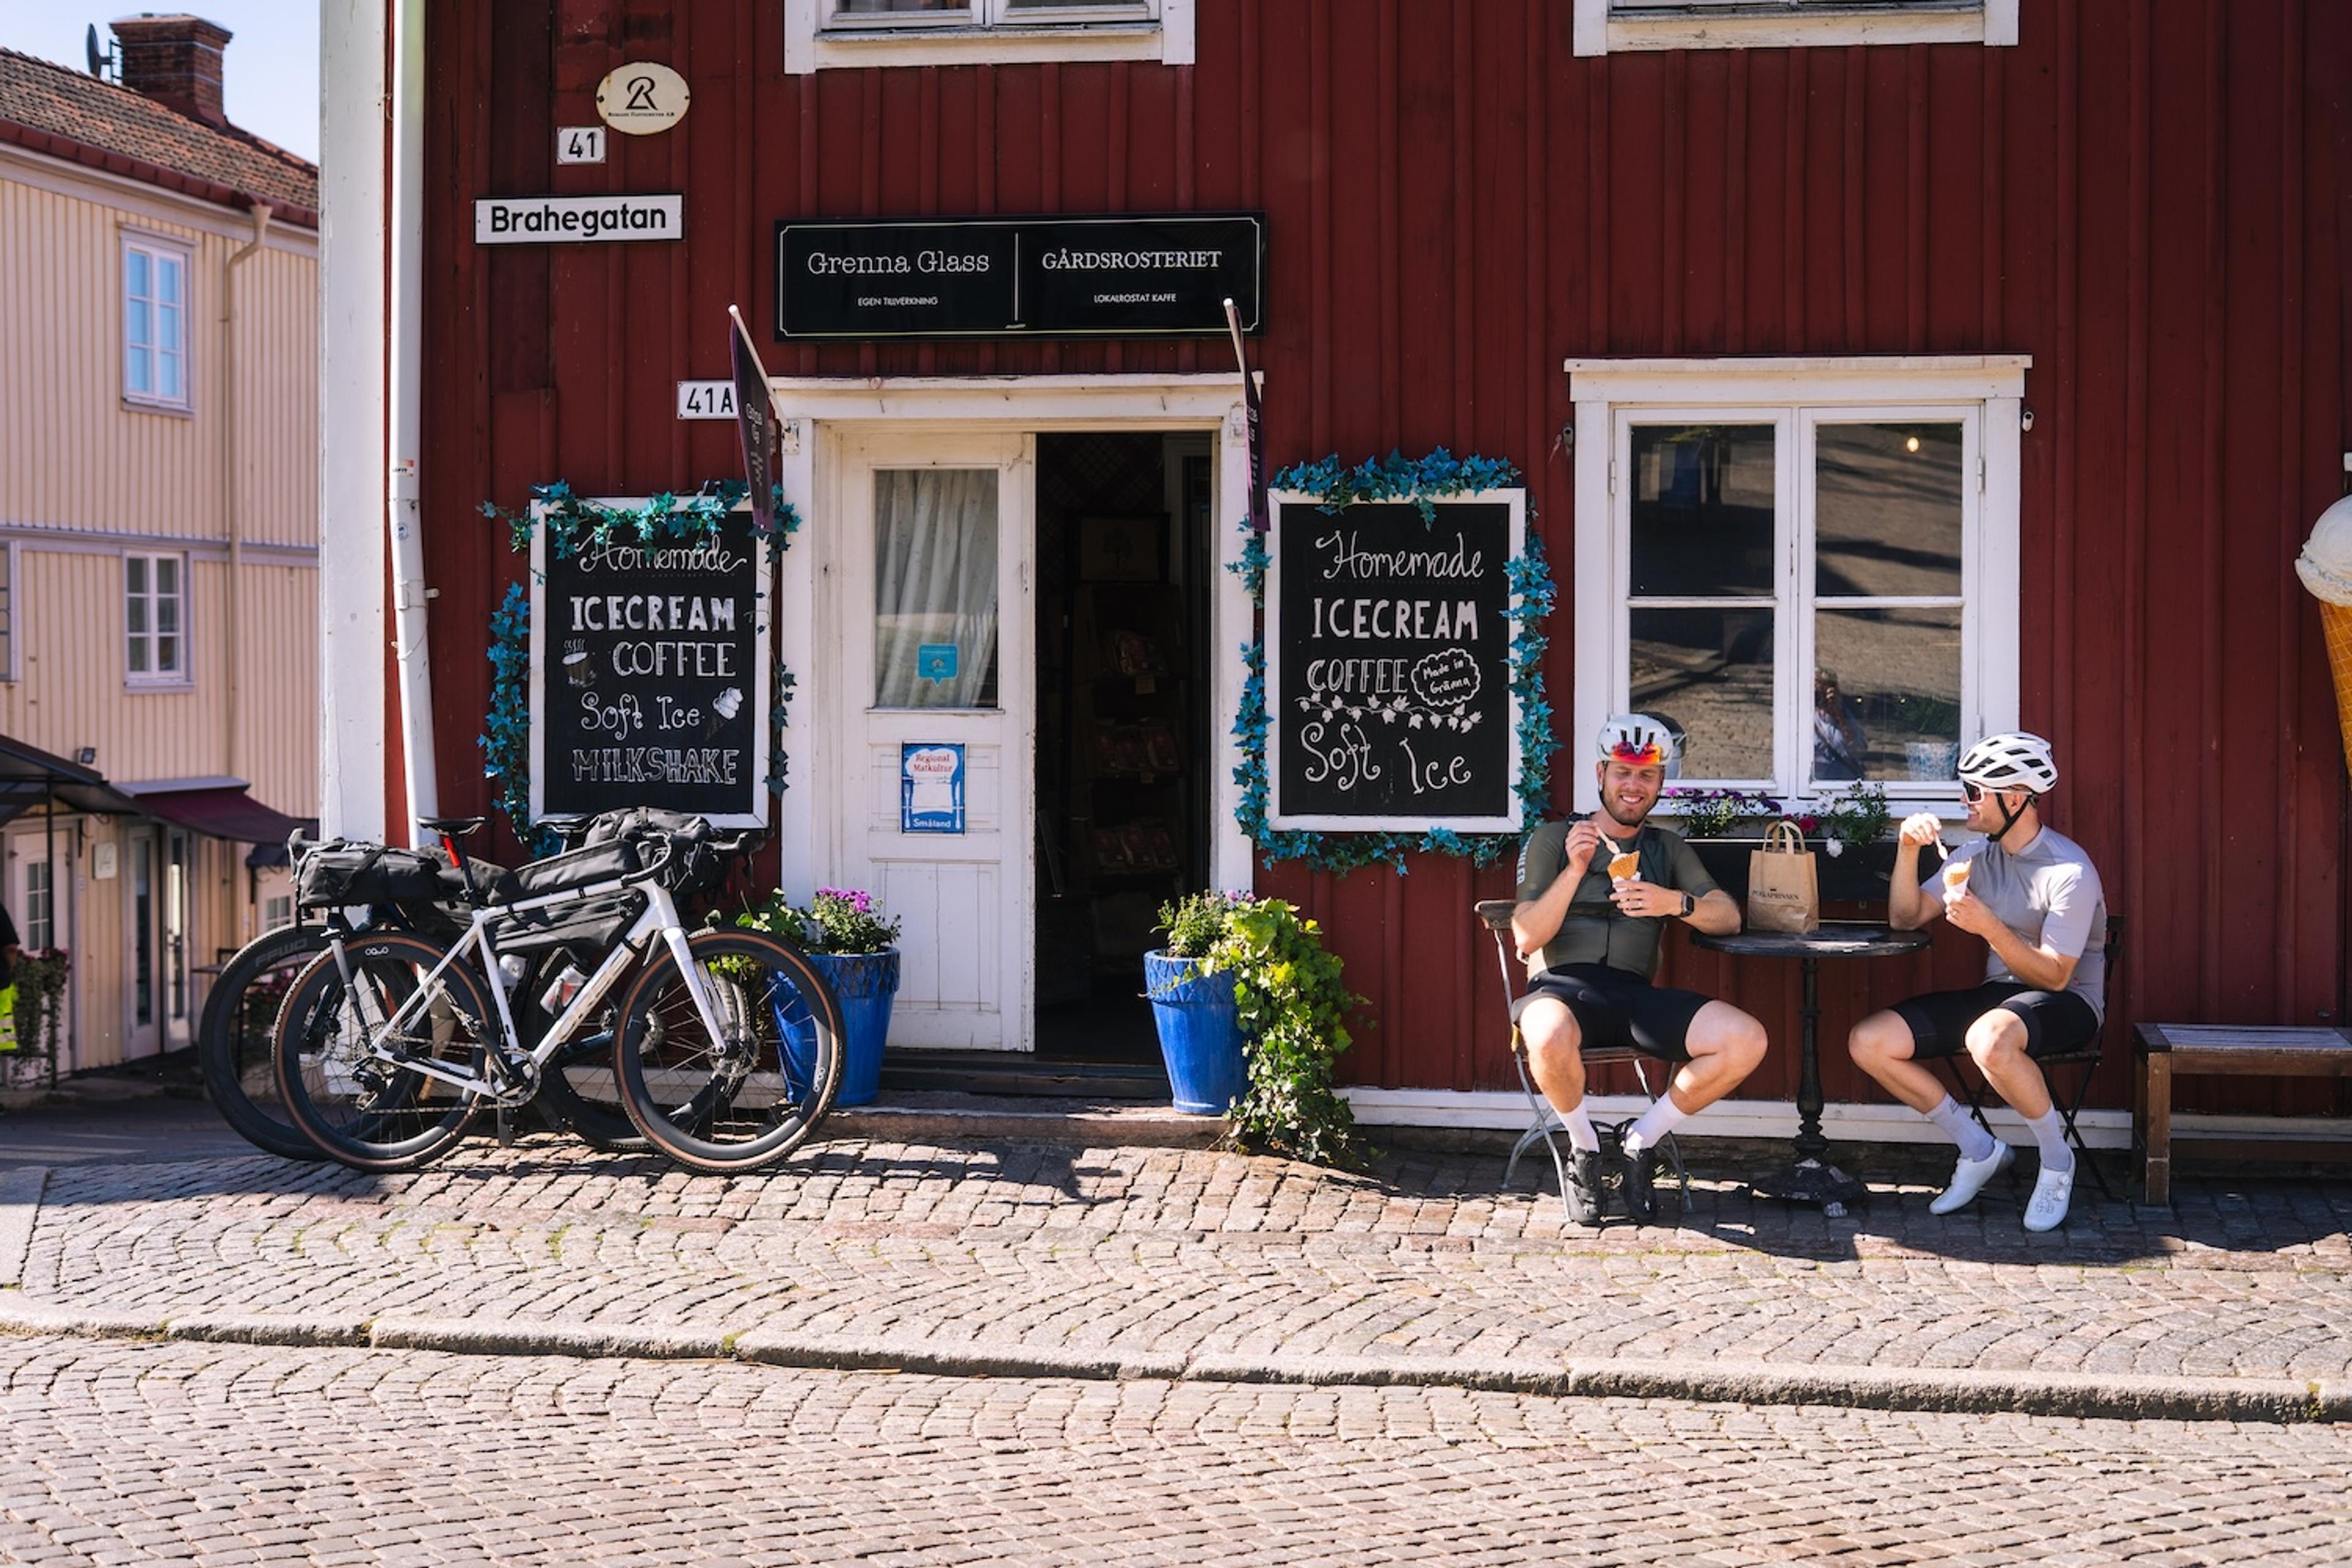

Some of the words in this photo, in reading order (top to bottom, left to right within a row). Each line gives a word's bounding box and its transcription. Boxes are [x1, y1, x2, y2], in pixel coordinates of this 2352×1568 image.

[568, 132, 597, 158] 41
[491, 203, 666, 238] Brahegatan
[807, 252, 911, 275] Grenna
[917, 250, 990, 273] Glass
[1041, 247, 1223, 270] GÅRDSROSTERIET
[857, 297, 881, 307] EGEN
[883, 296, 939, 306] TILLVERKNING
[1152, 293, 1177, 303] KAFFE
[687, 386, 734, 413] 41A
[575, 529, 747, 574] Homemade
[1315, 530, 1485, 579] Homemade
[570, 594, 736, 632] ICECREAM
[1311, 598, 1479, 641] ICECREAM
[612, 641, 736, 677] COFFEE
[1423, 663, 1450, 680] Made
[1453, 658, 1464, 670] in
[1306, 658, 1409, 694] COFFEE
[1430, 677, 1471, 694] Gränna
[581, 691, 644, 741] Soft
[656, 695, 701, 731] Ice
[571, 746, 740, 785] MILKSHAKE
[913, 763, 953, 772] Matkultur
[916, 753, 950, 764] Regional
[1301, 722, 1381, 791] Soft
[1399, 737, 1471, 795] Ice
[913, 817, 951, 828] Småland
